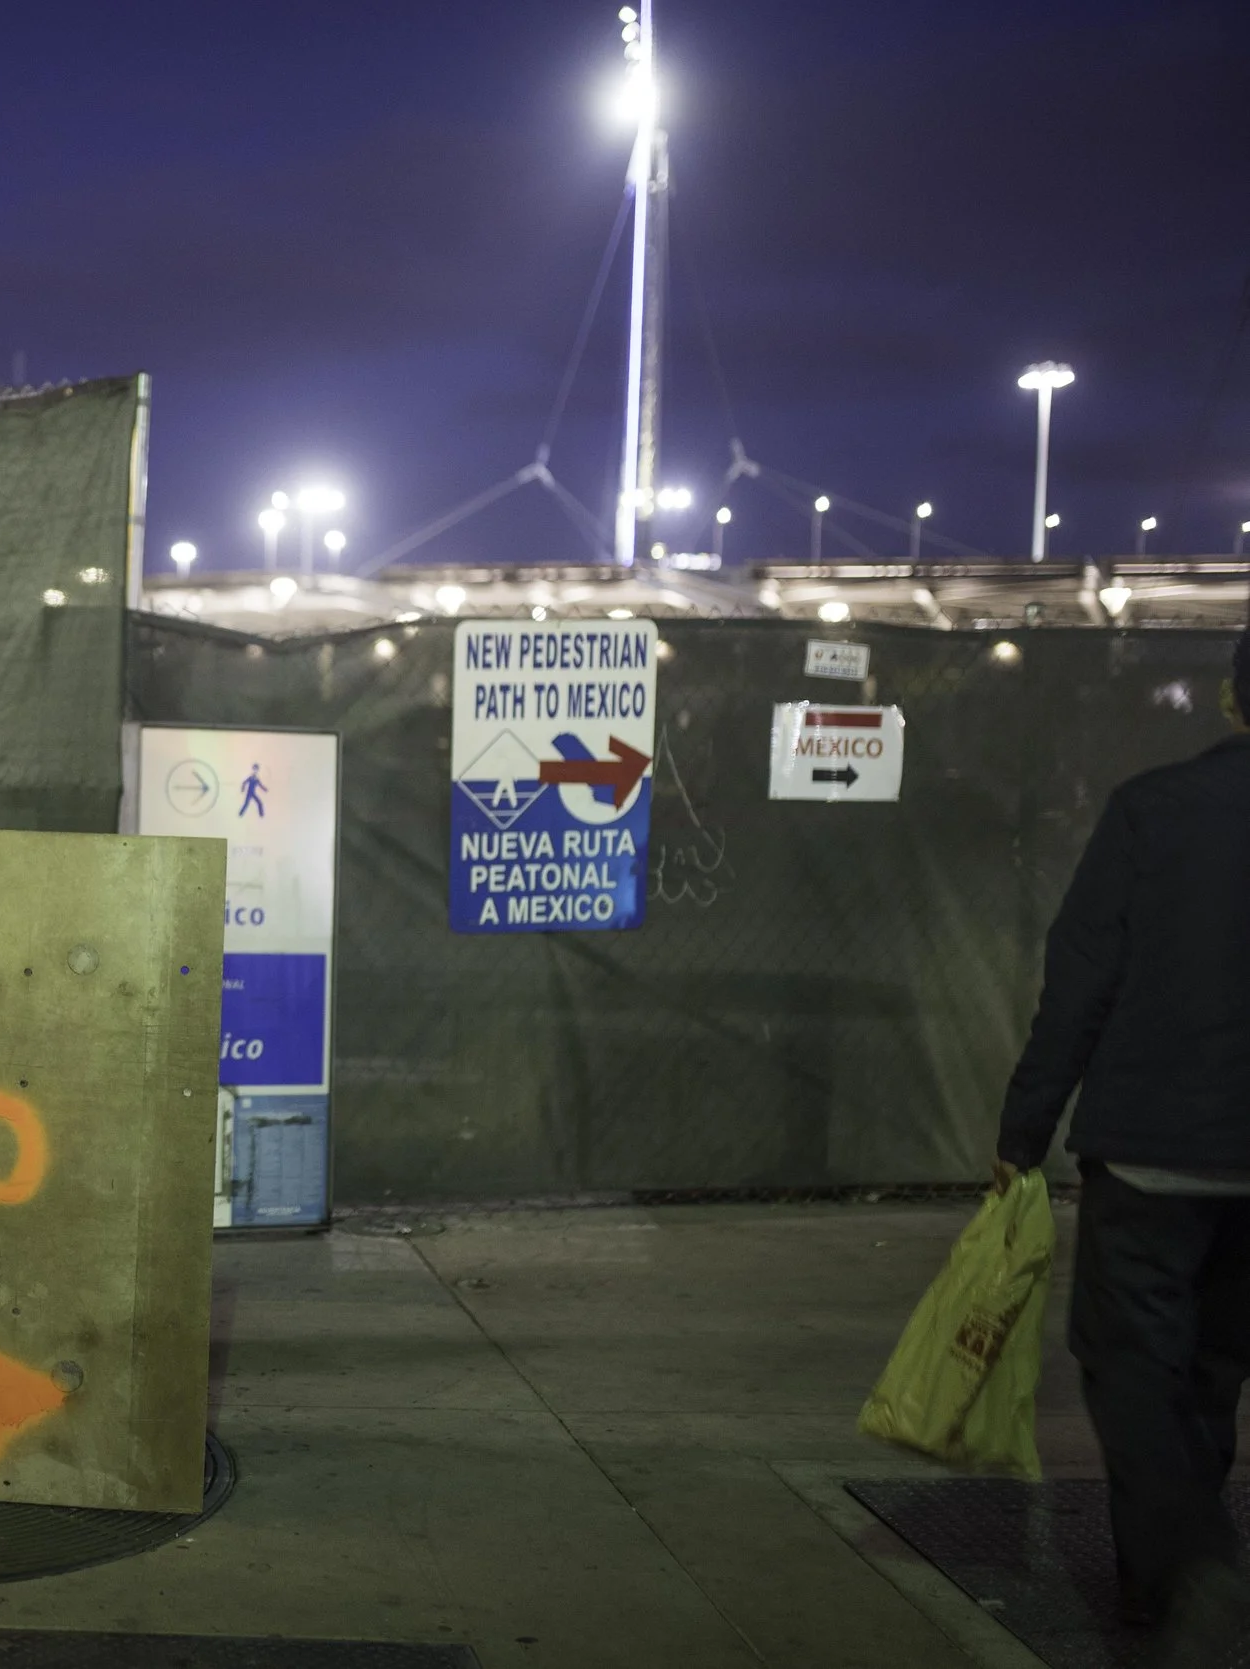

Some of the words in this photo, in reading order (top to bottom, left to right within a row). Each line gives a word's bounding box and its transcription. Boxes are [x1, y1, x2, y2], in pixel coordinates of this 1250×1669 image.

[466, 634, 512, 669] NEW
[519, 633, 647, 669] PEDESTRIAN
[475, 684, 525, 720] PATH
[534, 684, 559, 719] TO
[567, 683, 645, 719] MEXICO
[795, 736, 883, 760] MEXICO
[461, 831, 554, 860] NUEVA
[563, 829, 636, 857] RUTA
[470, 862, 616, 893] PEATONAL
[479, 898, 499, 925] A
[508, 894, 614, 924] MEXICO
[220, 1032, 264, 1060] ico
